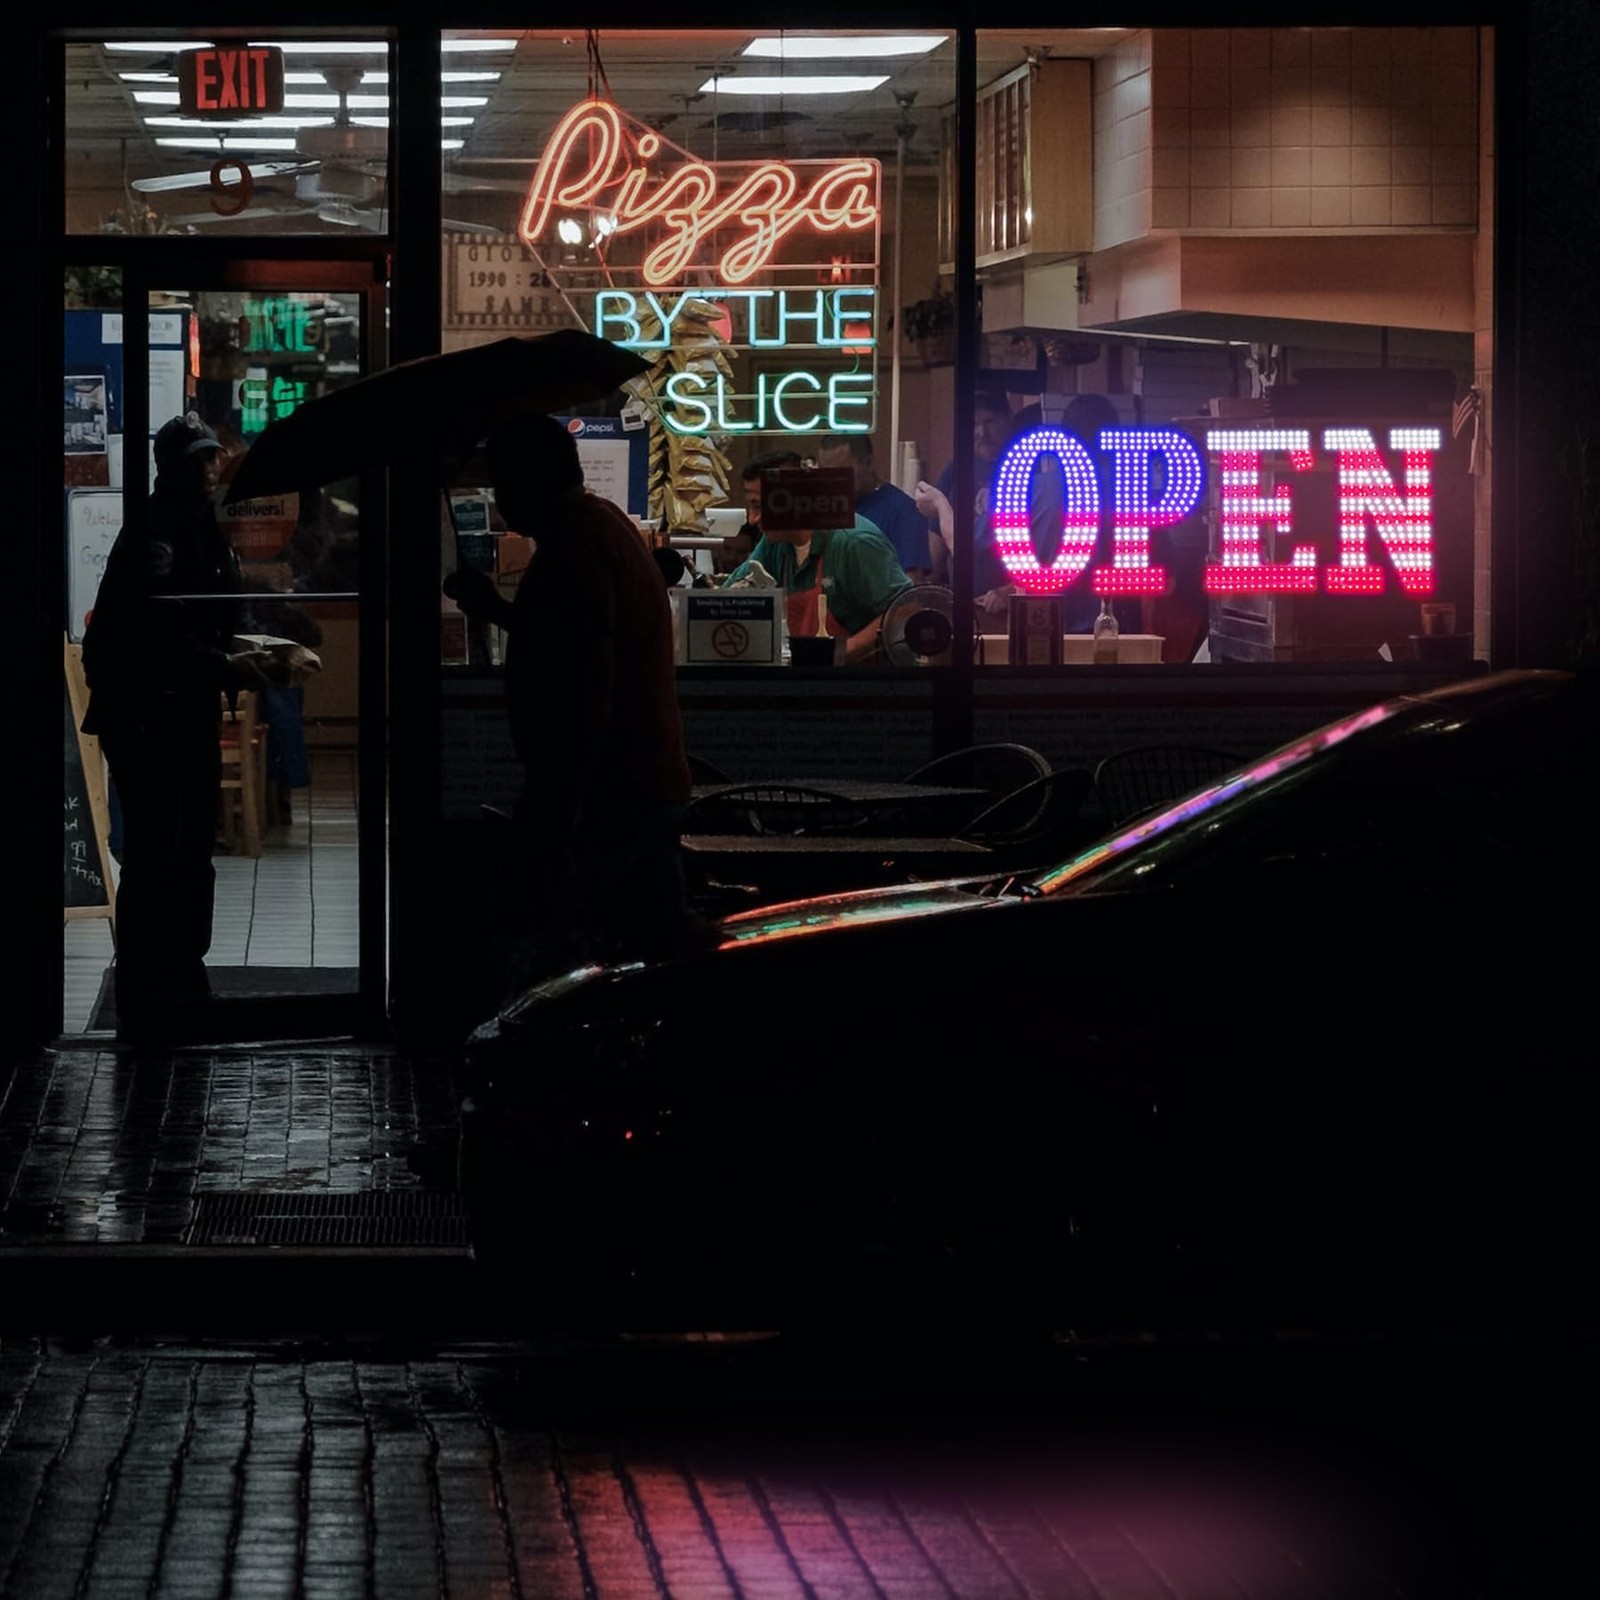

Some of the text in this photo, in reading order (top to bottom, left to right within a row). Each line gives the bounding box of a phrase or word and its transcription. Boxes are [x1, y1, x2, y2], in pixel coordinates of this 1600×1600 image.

[195, 50, 269, 109] EXIT
[210, 159, 253, 216] 9
[521, 101, 877, 285] Pizza
[469, 272, 506, 287] 1990
[595, 289, 877, 347] BY THE
[665, 372, 875, 433] SLICE
[767, 488, 849, 520] Open
[992, 427, 1441, 593] OPEN
